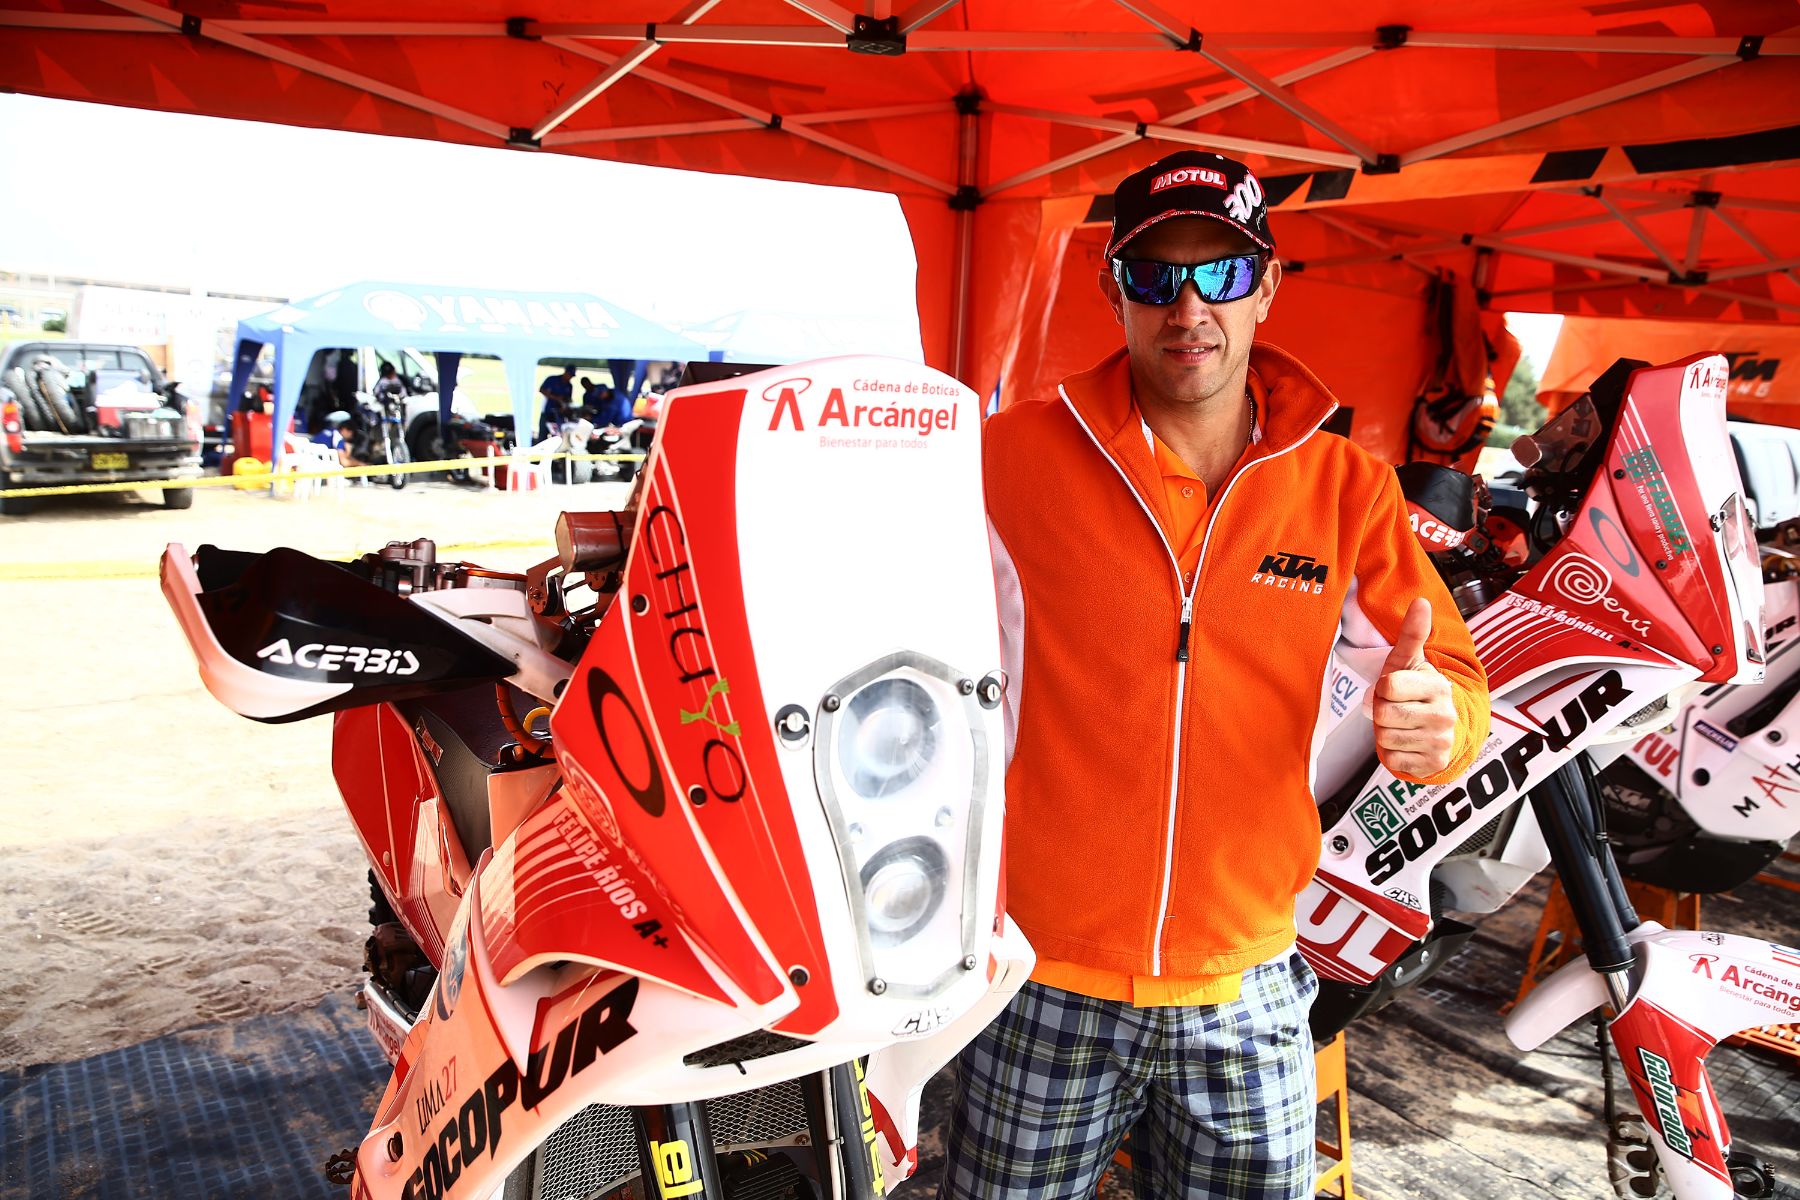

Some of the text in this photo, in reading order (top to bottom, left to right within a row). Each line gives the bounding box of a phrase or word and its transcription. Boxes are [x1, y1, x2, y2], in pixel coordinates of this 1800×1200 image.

[1153, 169, 1225, 190] MOTUL
[421, 294, 621, 337] YAMAHA
[853, 379, 960, 397] Cádena de Boticas
[818, 387, 958, 436] Arcángel
[819, 436, 928, 450] Bienestar para todos
[1647, 479, 1692, 555] FARMEX
[1257, 552, 1328, 583] KTM
[1251, 573, 1324, 594] RACING
[1537, 552, 1652, 637] Perú
[1507, 596, 1555, 619] ISRAEL
[1365, 669, 1634, 886] SOCOPUR
[553, 808, 607, 870] FELIPE
[632, 919, 669, 949] A+
[1383, 887, 1422, 910] CHS
[1720, 965, 1800, 1012] Arcáng
[1744, 965, 1779, 983] Cádena
[1781, 978, 1794, 987] de
[1754, 999, 1771, 1010] para
[1773, 1005, 1796, 1018] todos
[1641, 1049, 1691, 1154] Gatorade
